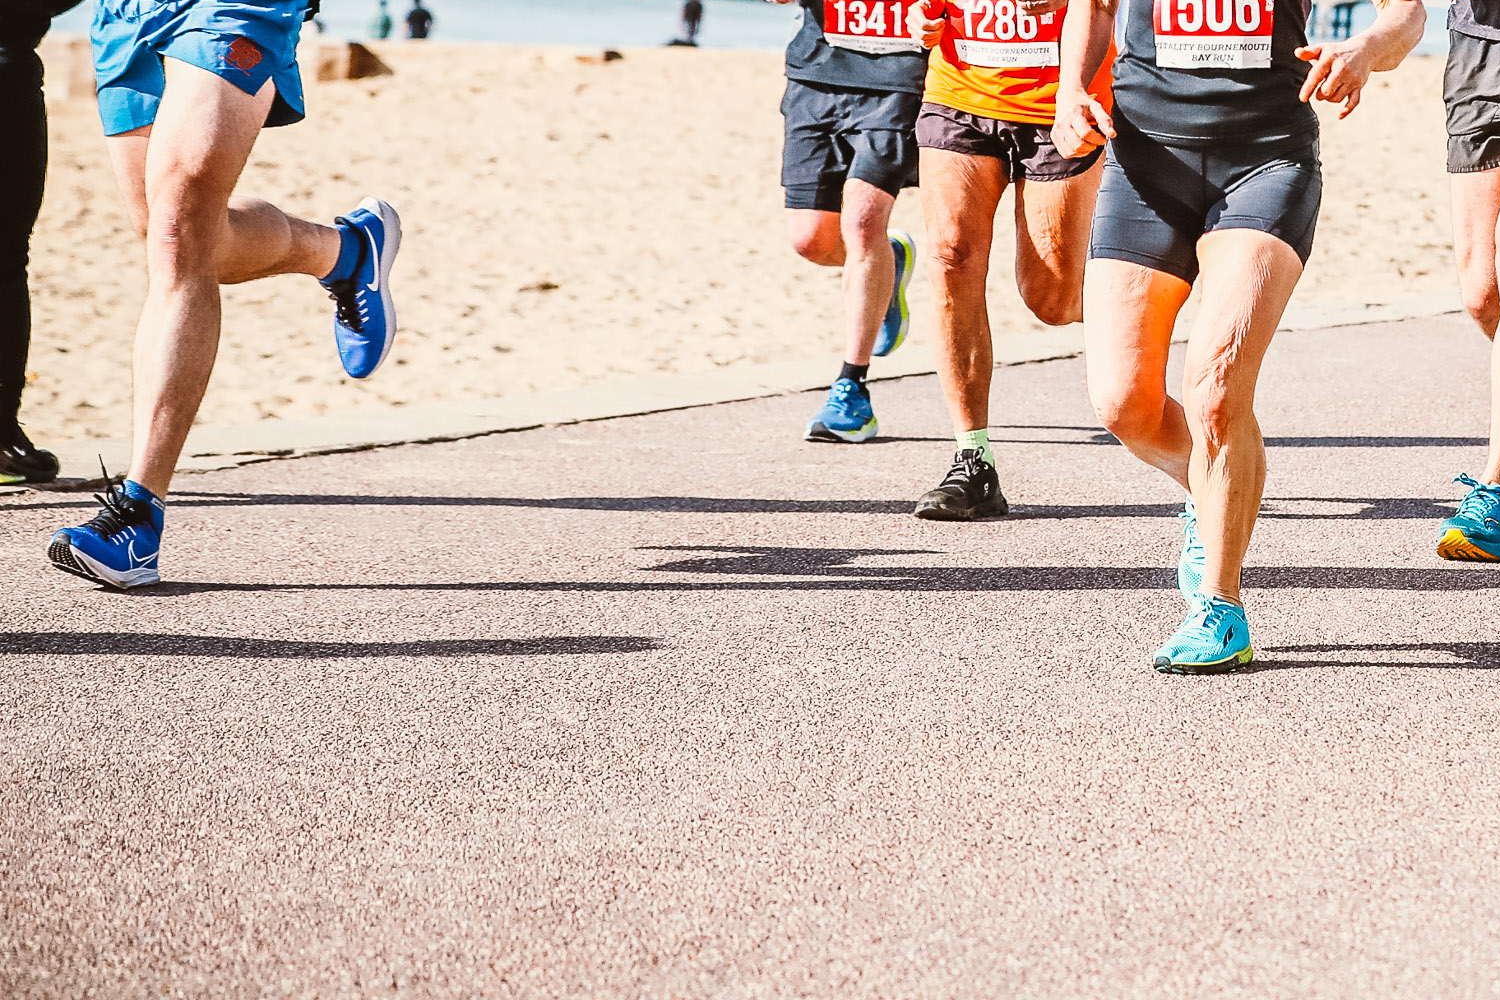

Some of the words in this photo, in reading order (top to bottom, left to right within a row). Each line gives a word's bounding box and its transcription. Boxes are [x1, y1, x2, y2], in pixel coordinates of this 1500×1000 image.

[833, 0, 902, 36] 1341
[991, 46, 1050, 55] BOURNEMOUTH
[1001, 55, 1018, 63] RUN
[1191, 54, 1212, 62] BAY
[1213, 54, 1235, 62] RUN
